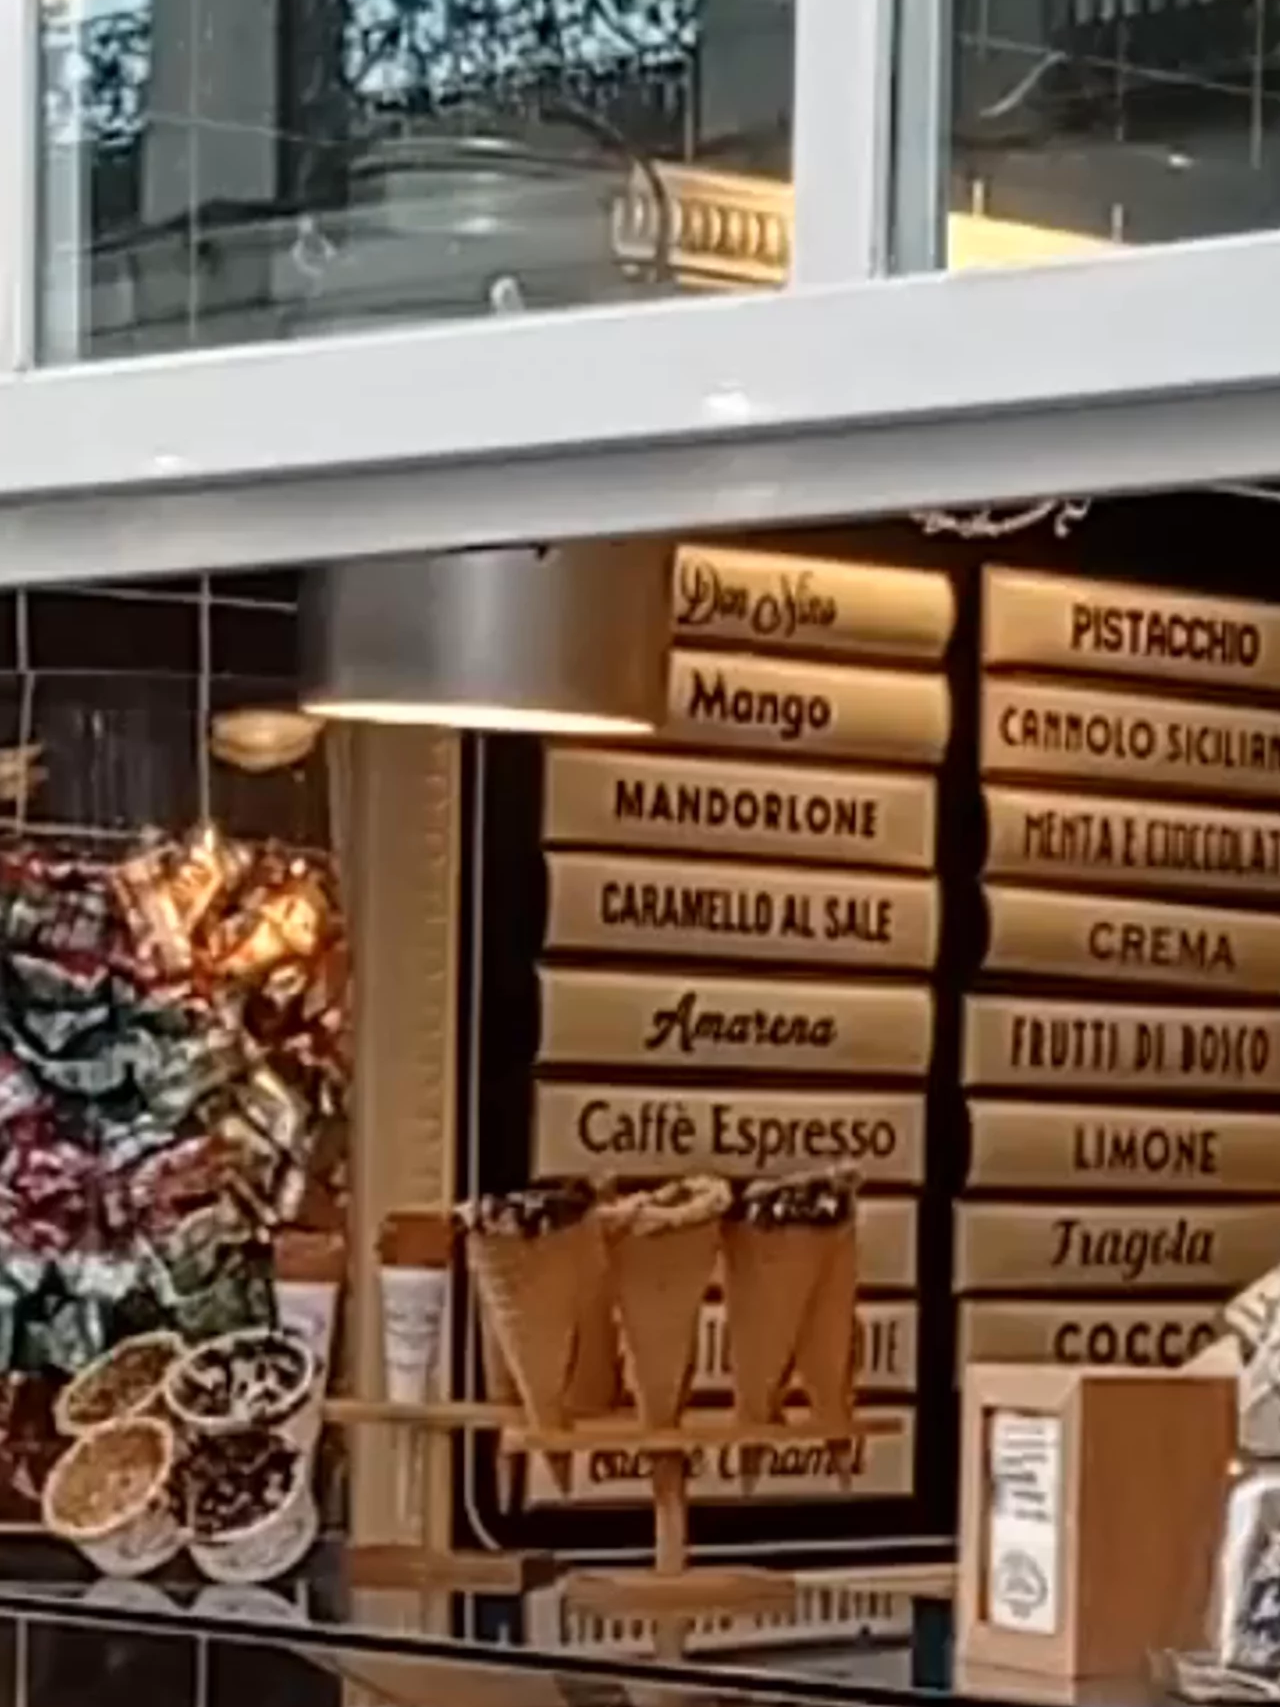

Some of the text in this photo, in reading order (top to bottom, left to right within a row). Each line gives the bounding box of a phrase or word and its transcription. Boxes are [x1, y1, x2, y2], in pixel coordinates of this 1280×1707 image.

[1071, 603, 1261, 667] PISTACCHIO
[688, 667, 833, 741] Mango
[999, 703, 1155, 761] CANNOLO
[614, 779, 879, 839] MANDORLONE
[1023, 810, 1115, 866] MENTA
[1122, 816, 1136, 867] E
[600, 881, 893, 944] CARAMELLO AL SALE
[1088, 921, 1238, 974] CREMA
[644, 990, 840, 1054] Amarena
[1010, 1015, 1270, 1080] FRUTTI DI BOSCO
[577, 1099, 898, 1169] Caffè Espresso
[1074, 1124, 1220, 1175] LIMONE
